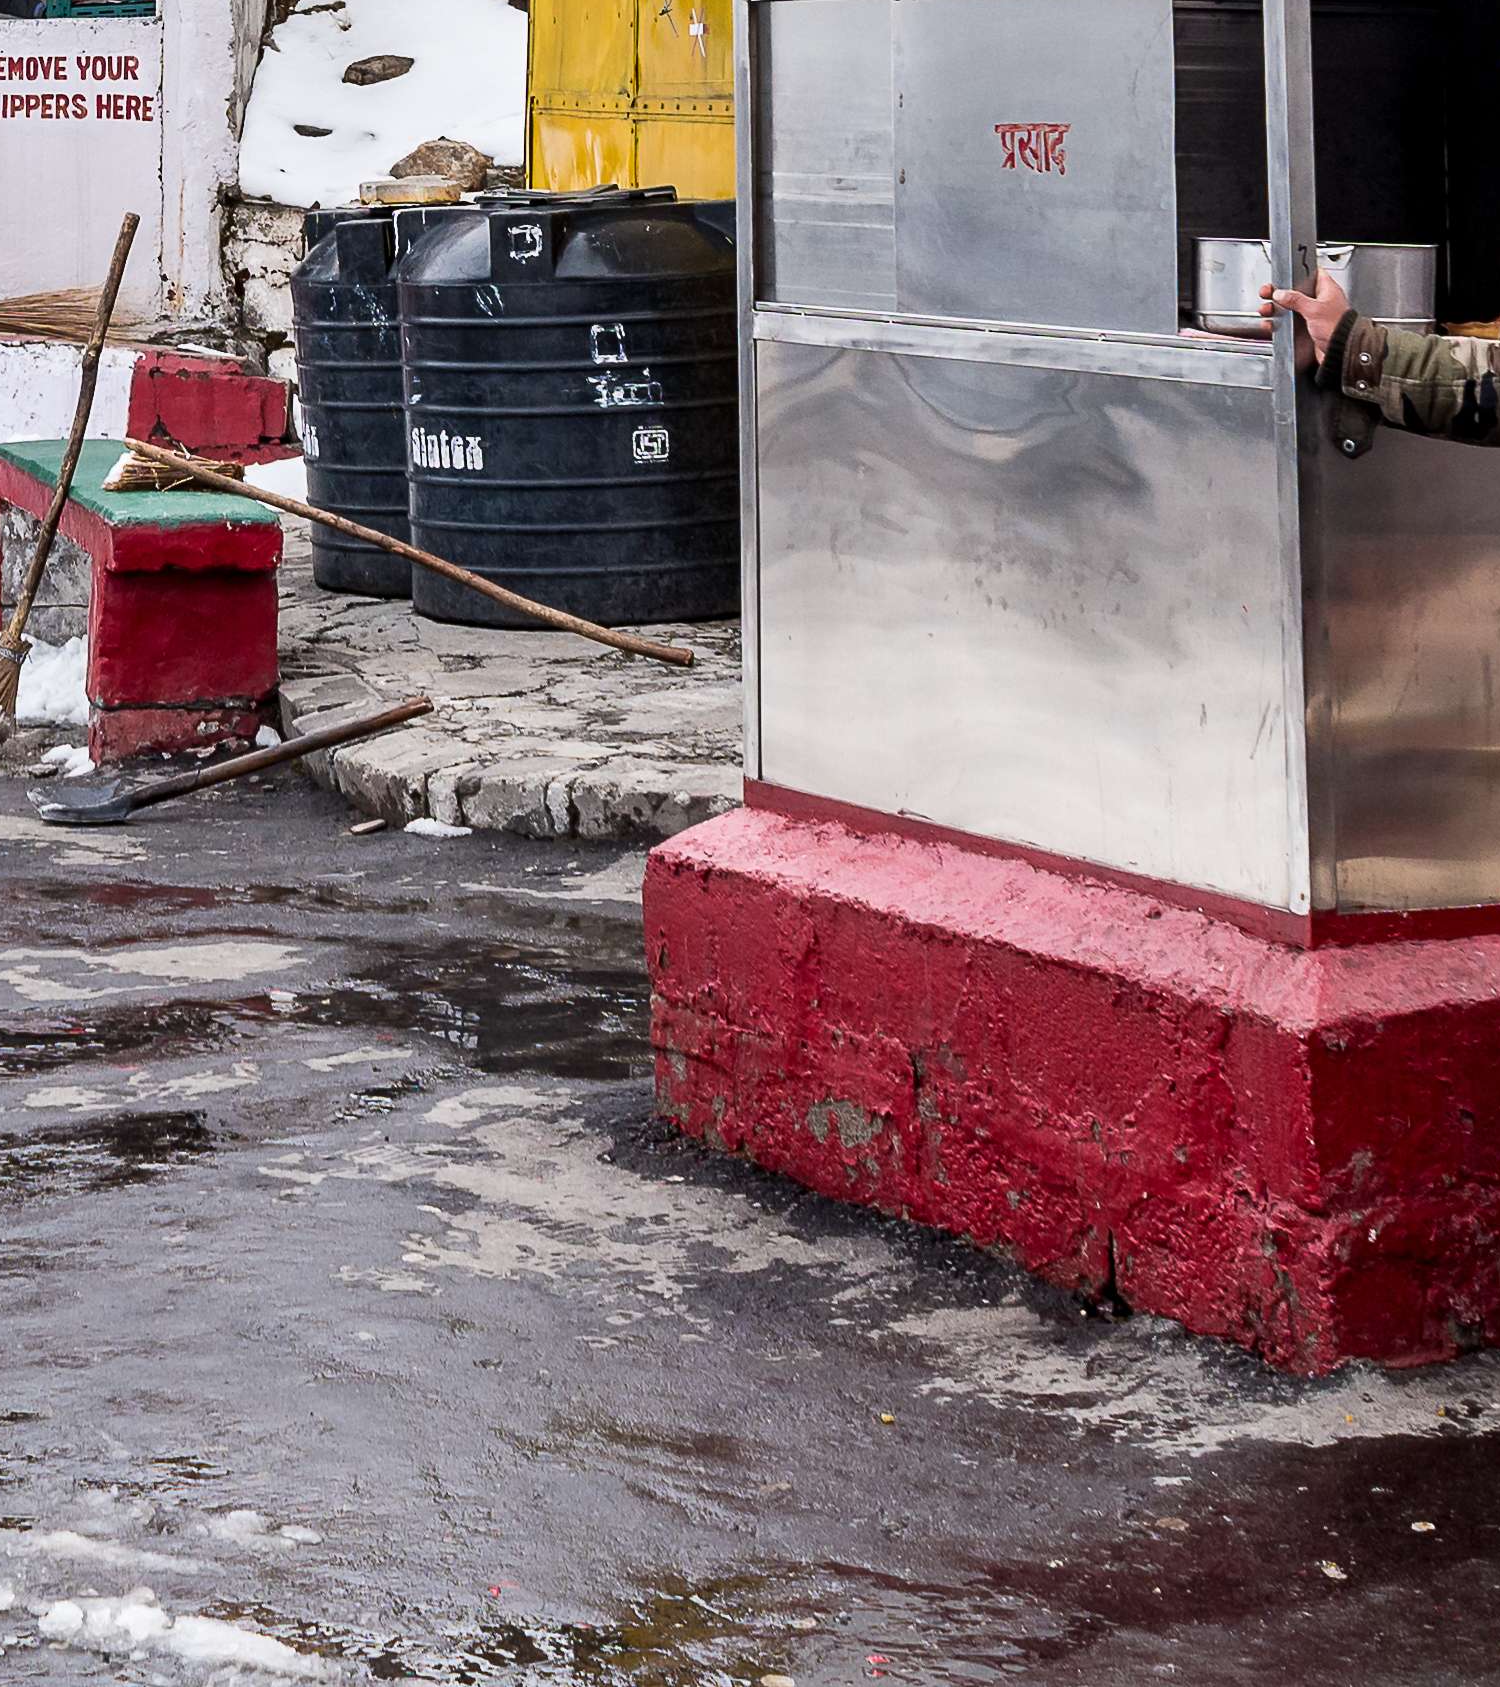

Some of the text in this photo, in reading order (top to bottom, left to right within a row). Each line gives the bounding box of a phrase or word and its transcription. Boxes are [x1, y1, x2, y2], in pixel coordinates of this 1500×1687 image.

[76, 55, 139, 81] YOUR
[96, 94, 155, 122] HERE
[994, 122, 1072, 176] प्रसाद
[411, 427, 484, 470] Sintex
